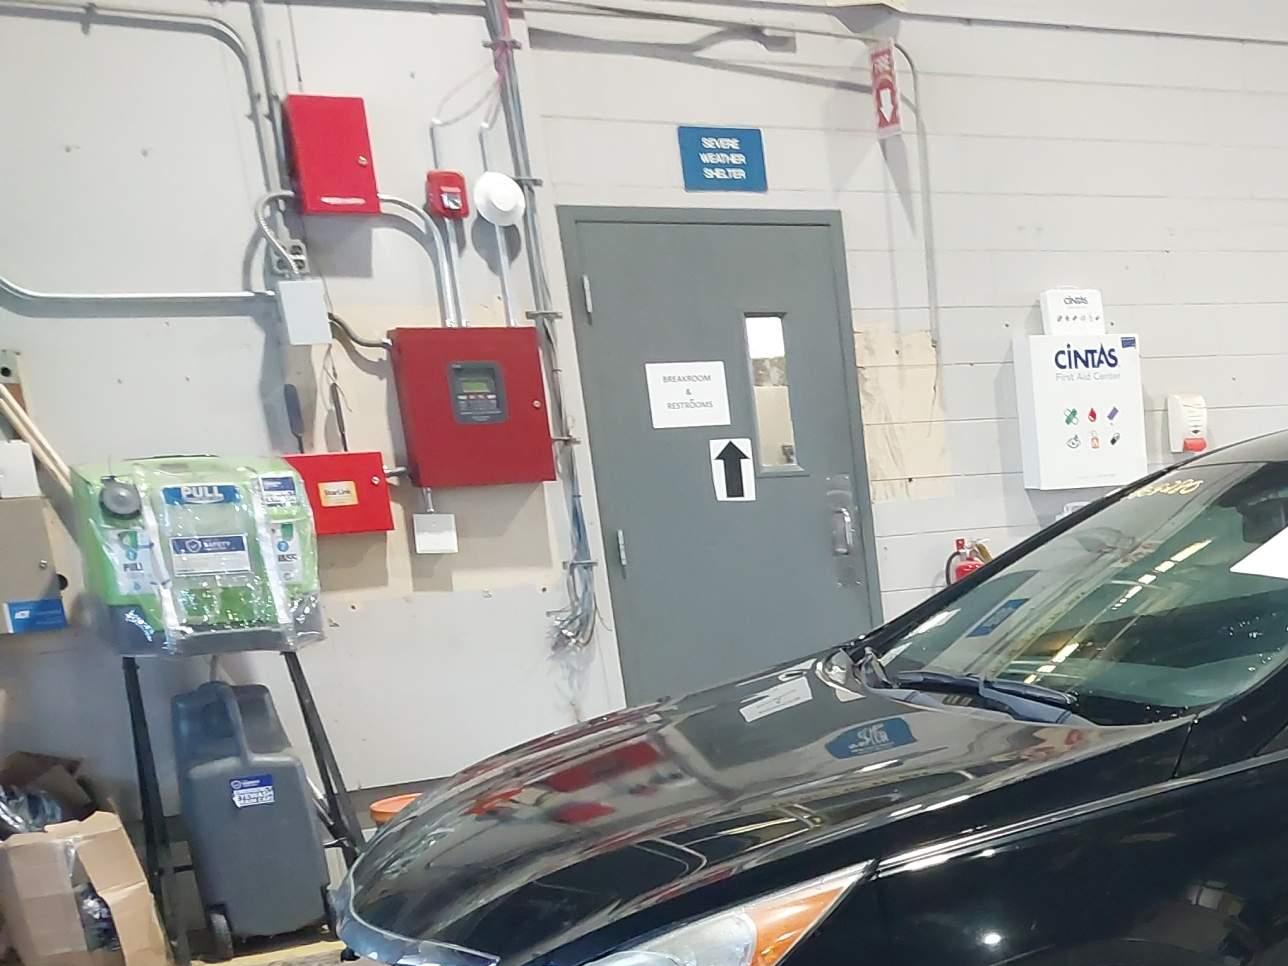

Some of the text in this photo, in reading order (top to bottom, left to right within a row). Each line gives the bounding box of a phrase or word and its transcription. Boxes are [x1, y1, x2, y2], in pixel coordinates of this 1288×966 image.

[701, 137, 740, 149] SEVERE
[699, 152, 747, 164] WEATHER
[702, 167, 746, 179] SHELTER
[662, 375, 712, 383] BREAKROOM
[685, 388, 692, 396] &
[667, 401, 714, 410] RESTROOMS
[181, 486, 224, 498] PULL
